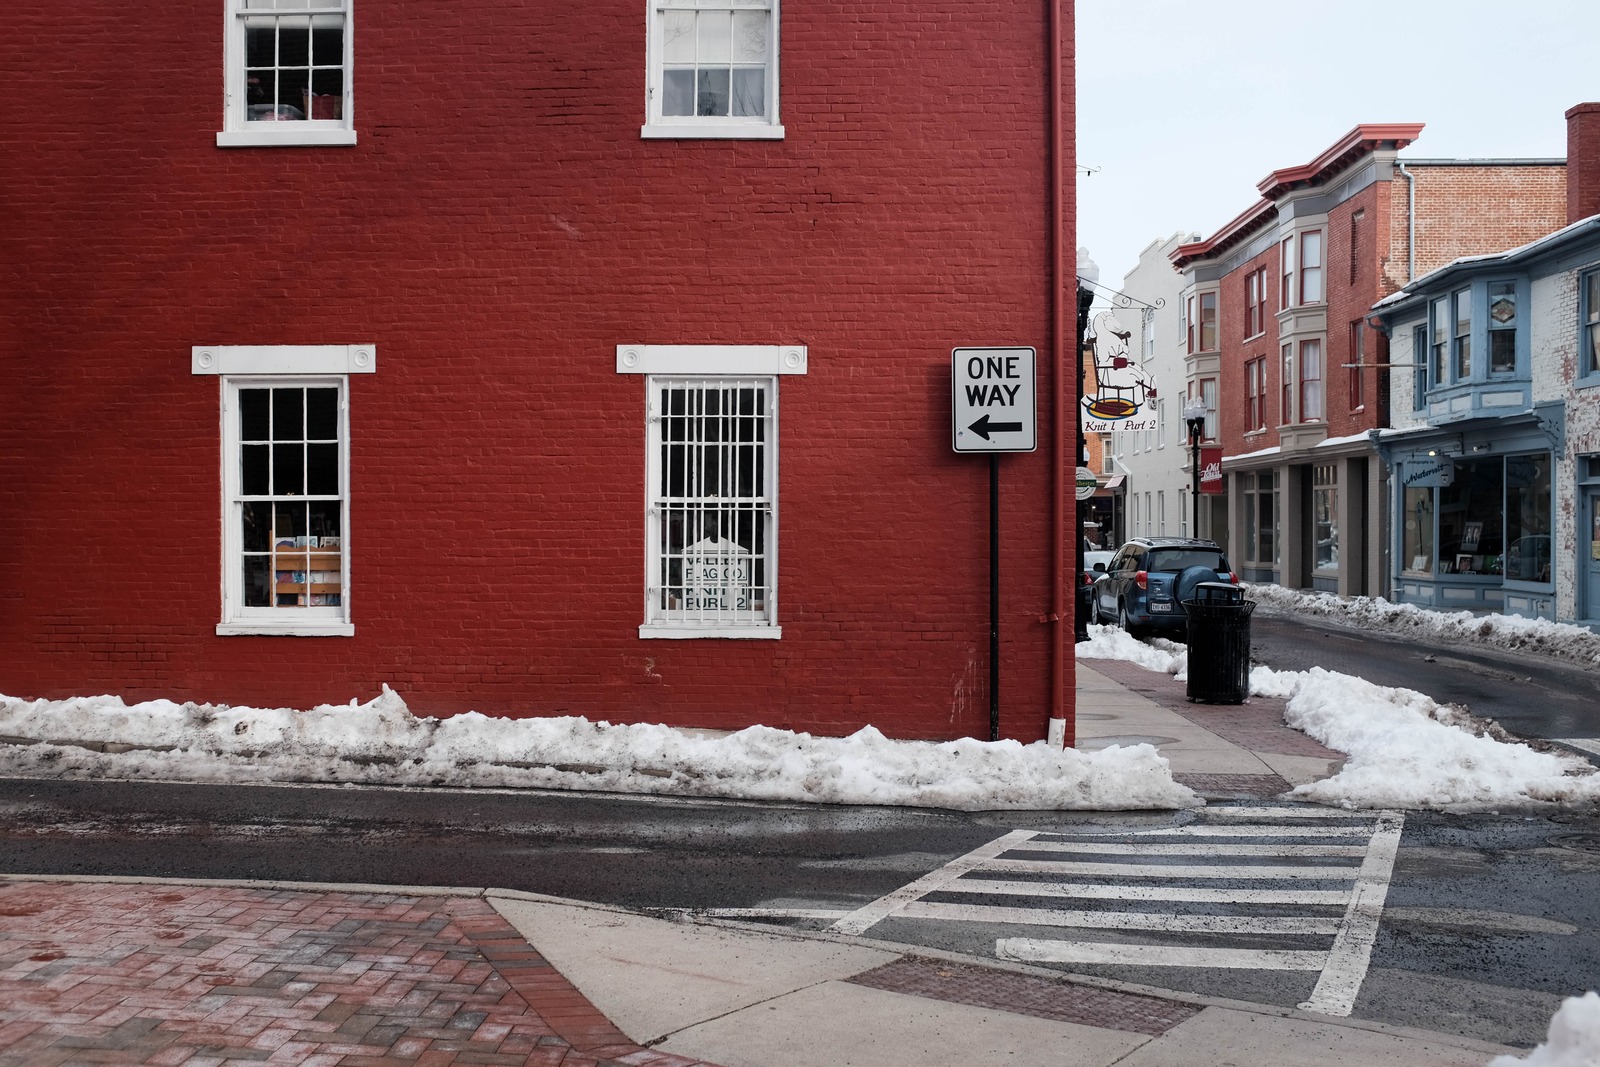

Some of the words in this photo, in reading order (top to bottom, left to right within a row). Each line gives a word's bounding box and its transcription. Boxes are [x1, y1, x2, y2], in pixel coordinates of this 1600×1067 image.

[968, 357, 1020, 379] ONE
[965, 384, 1021, 407] WAY
[1085, 421, 1107, 431] Knit
[1124, 420, 1146, 430] Purl
[1149, 420, 1156, 430] 2
[686, 568, 718, 579] FAG
[736, 597, 746, 608] 2
